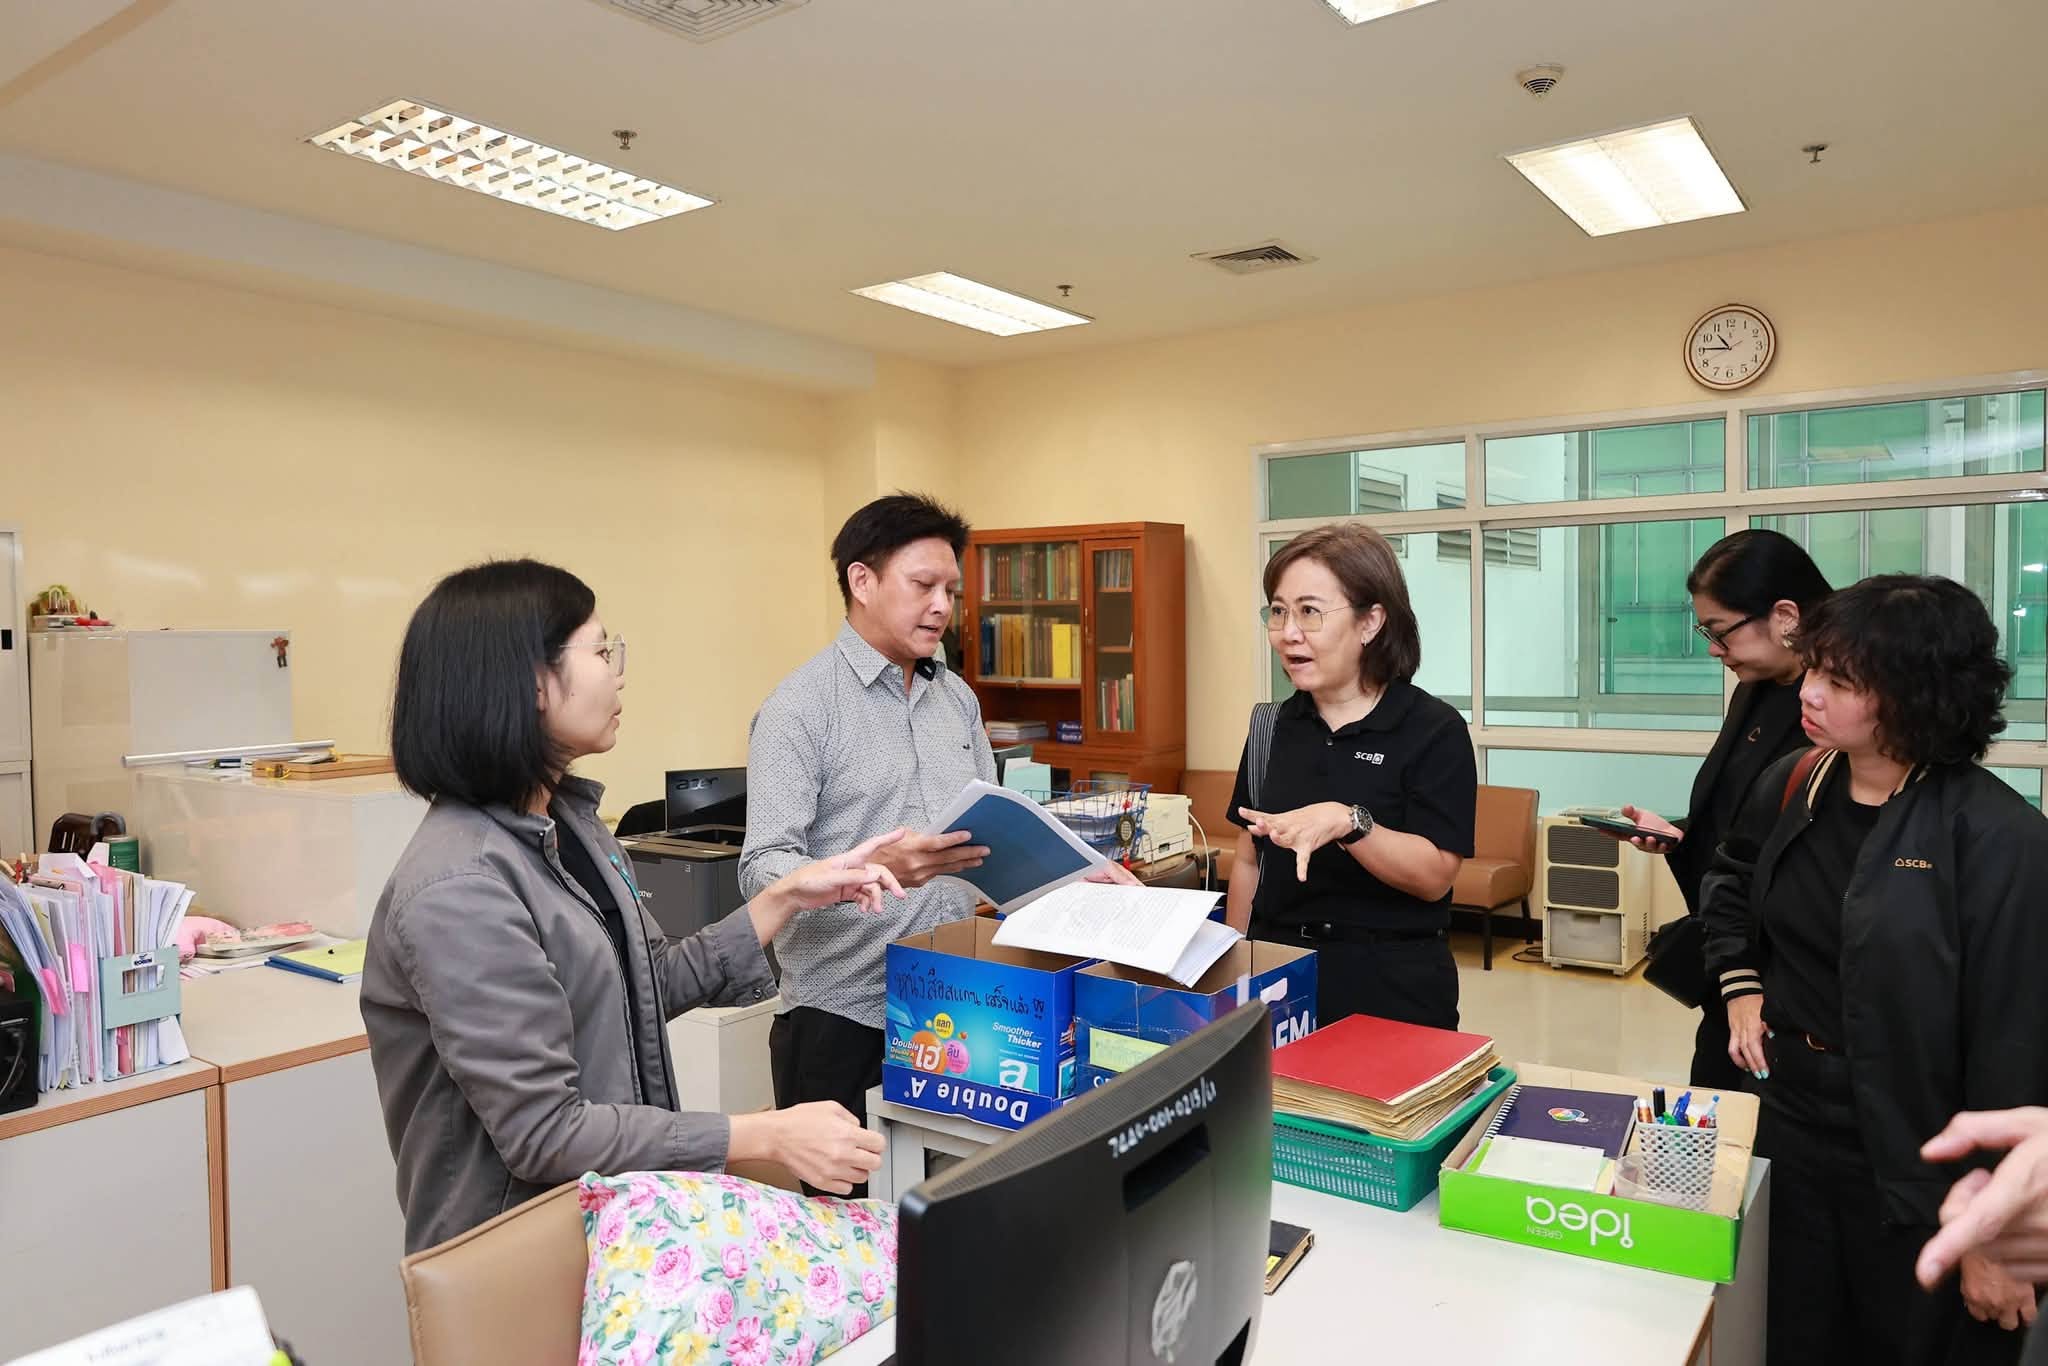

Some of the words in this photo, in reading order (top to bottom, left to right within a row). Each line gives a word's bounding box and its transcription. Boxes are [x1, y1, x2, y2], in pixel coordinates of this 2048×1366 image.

[1714, 323, 1720, 332] 11
[1726, 319, 1736, 328] 12
[1752, 328, 1759, 338] 2
[1703, 334, 1713, 343] 10
[1756, 341, 1763, 351] 3
[1702, 359, 1709, 368] 8
[1740, 364, 1748, 373] 5
[1713, 366, 1720, 376] 7
[1726, 369, 1733, 378] 6
[676, 776, 719, 790] acer
[992, 1022, 1034, 1038] Smoother
[1008, 1034, 1042, 1049] Thicker
[937, 1083, 1029, 1122] Double
[1526, 1196, 1634, 1248] idea
[1527, 1226, 1563, 1241] GREEN
